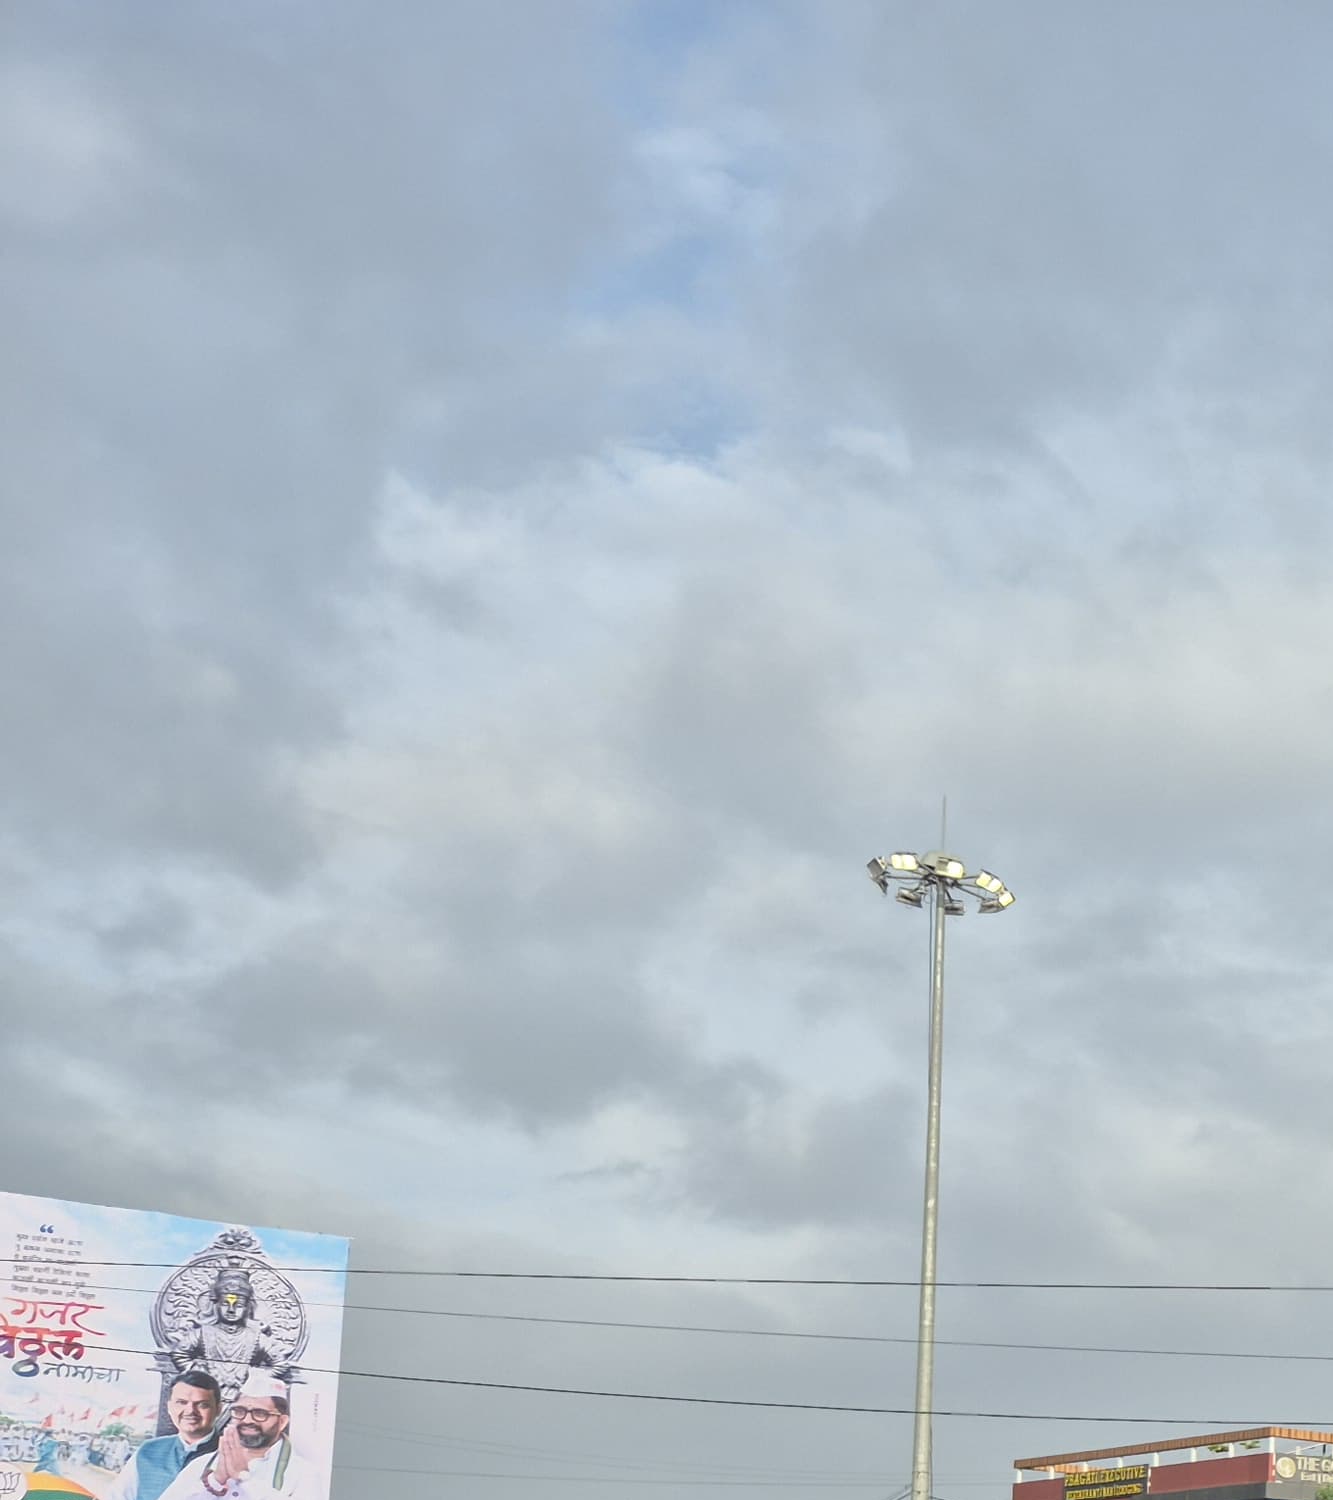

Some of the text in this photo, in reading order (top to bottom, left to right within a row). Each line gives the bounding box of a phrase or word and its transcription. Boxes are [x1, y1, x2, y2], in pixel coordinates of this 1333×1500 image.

[4, 1297, 106, 1335] गजर
[42, 1362, 127, 1383] नामाचा
[1296, 1456, 1321, 1472] THE
[1064, 1466, 1146, 1487] PRAGATI EXECUTIVE
